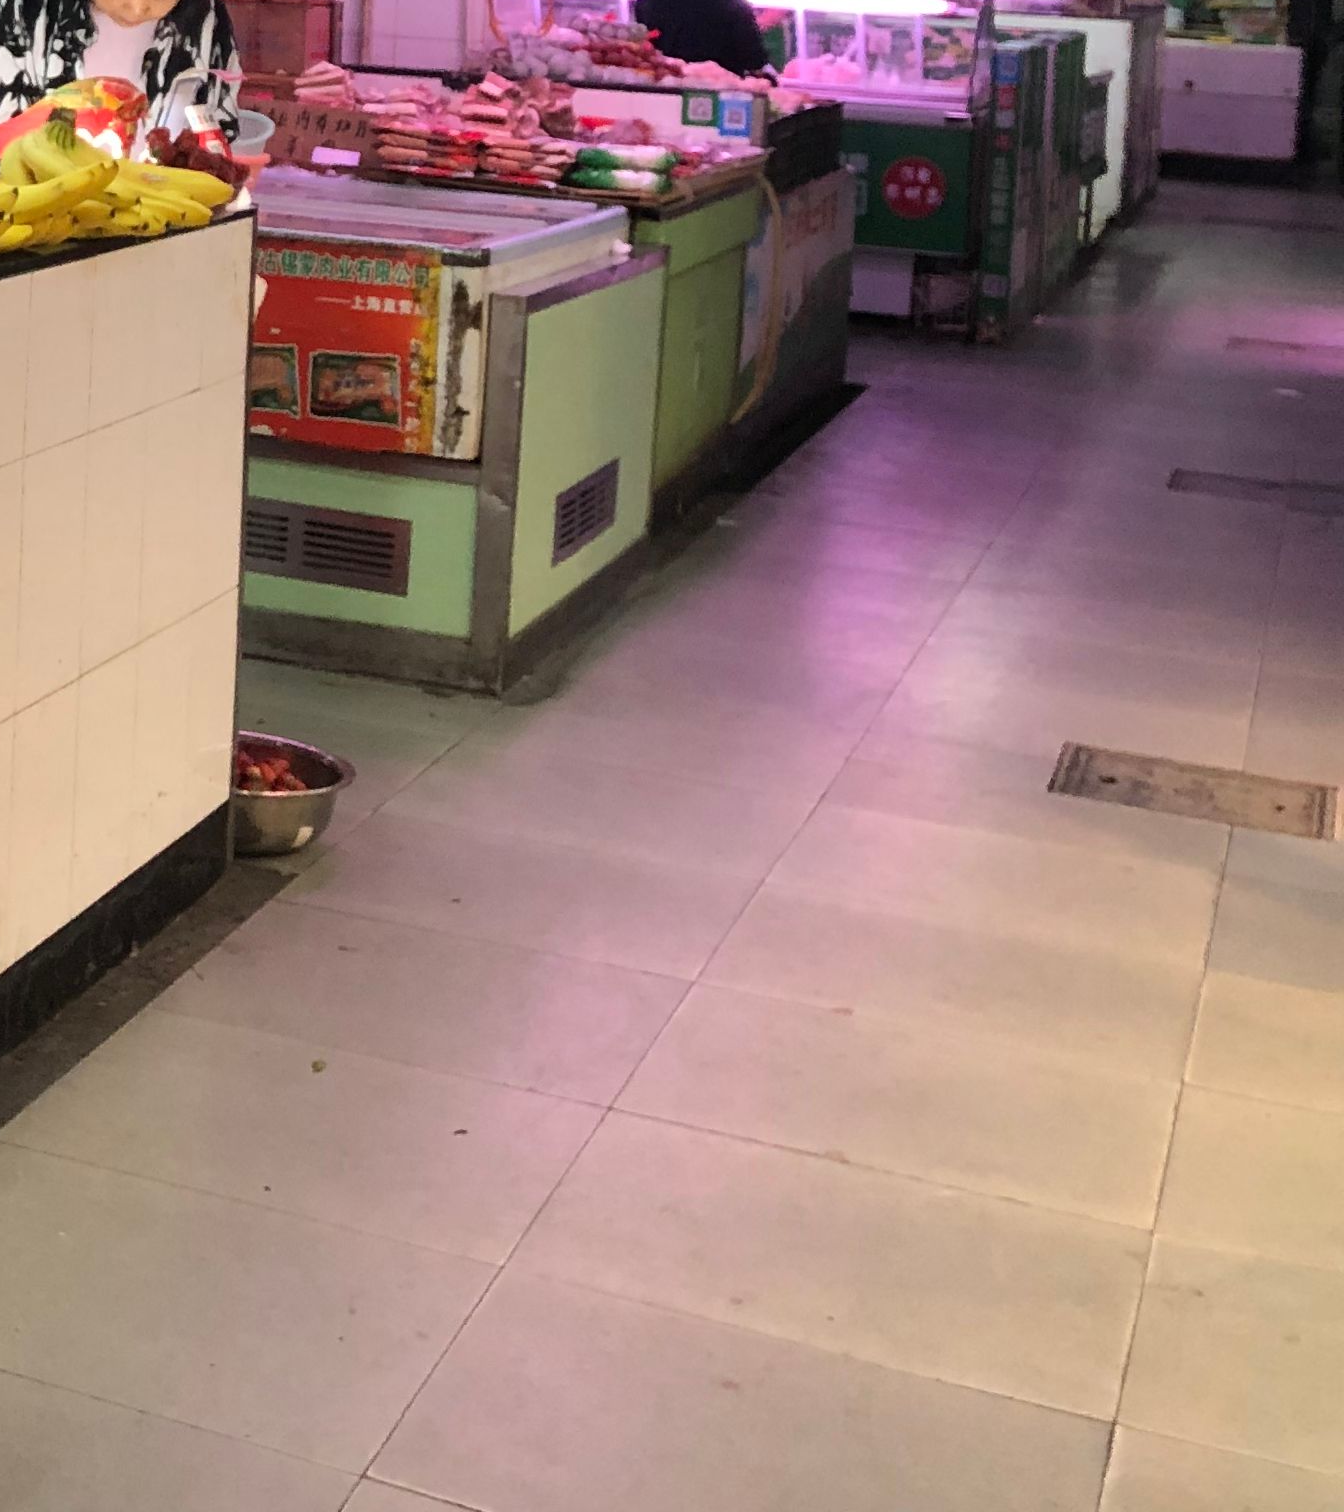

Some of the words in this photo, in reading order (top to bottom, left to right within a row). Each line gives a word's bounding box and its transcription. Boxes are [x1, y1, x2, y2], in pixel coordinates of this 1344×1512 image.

[255, 247, 430, 290] 古锡蒙肉业有限公司
